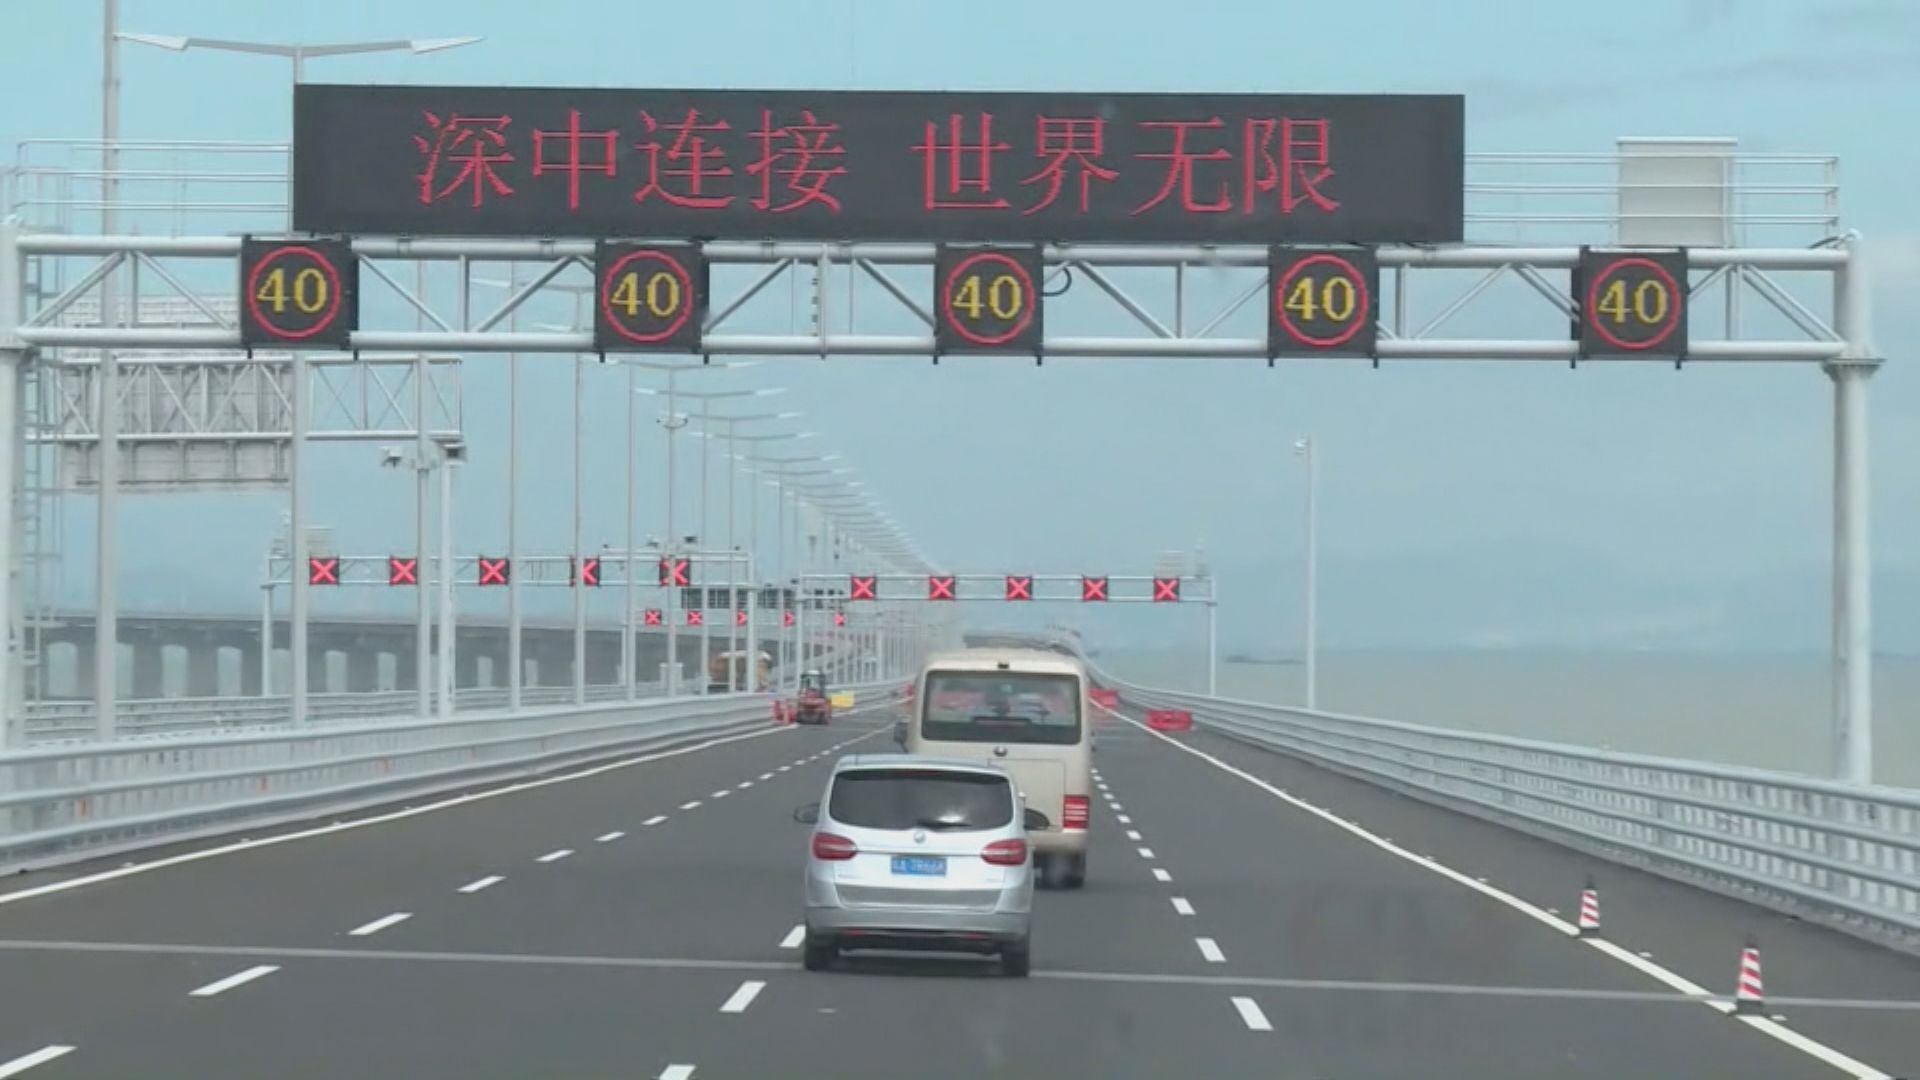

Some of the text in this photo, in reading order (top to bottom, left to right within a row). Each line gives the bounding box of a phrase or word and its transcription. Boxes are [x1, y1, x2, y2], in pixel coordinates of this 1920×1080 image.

[415, 109, 1340, 214] 深中连接 世界无限
[257, 269, 326, 313] 40
[611, 273, 679, 317] 40
[952, 275, 1020, 320] 40
[1284, 277, 1354, 321] 40
[1598, 280, 1668, 324] 40
